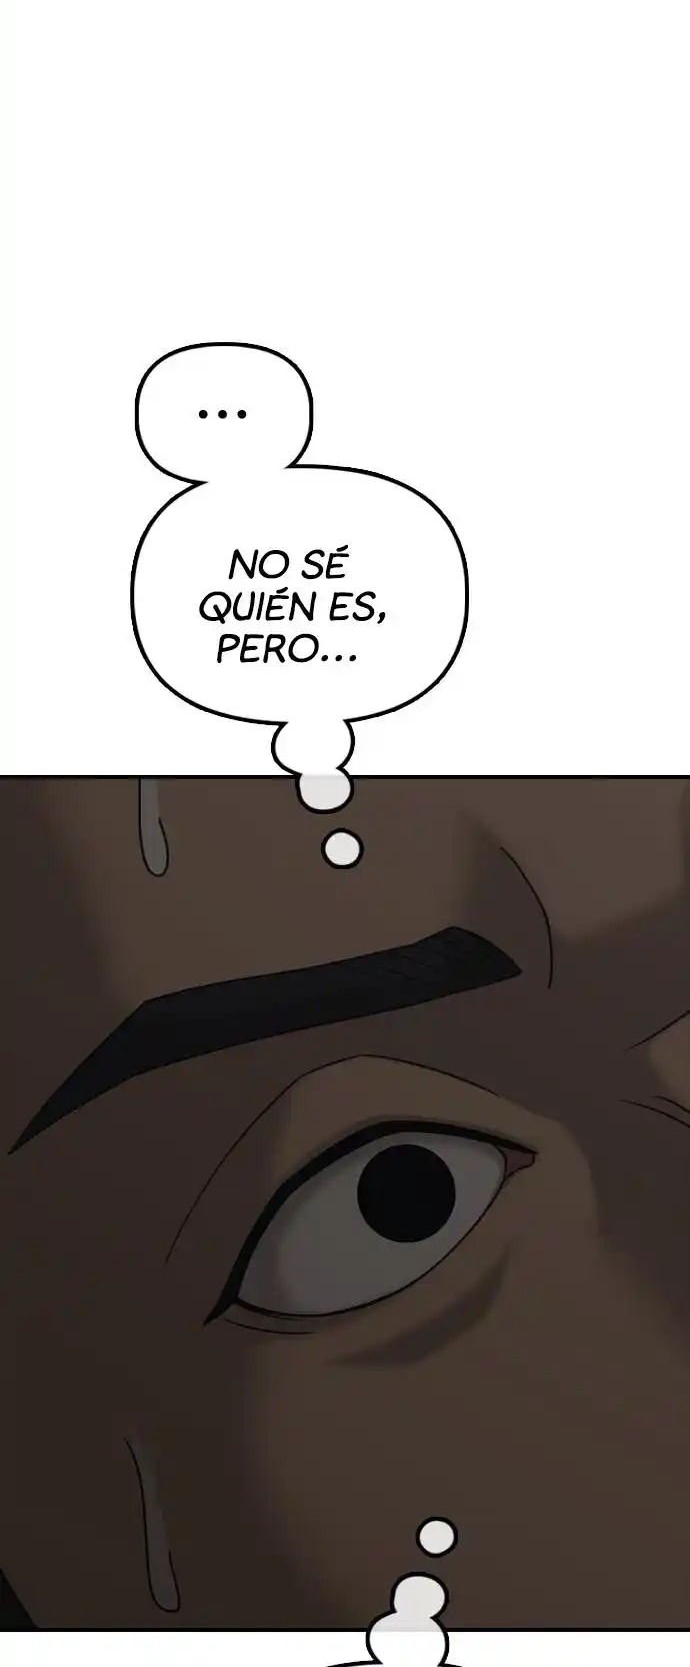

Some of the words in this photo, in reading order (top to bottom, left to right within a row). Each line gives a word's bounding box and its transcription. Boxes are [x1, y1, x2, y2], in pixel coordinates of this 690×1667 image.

[228, 548, 290, 580] NO
[301, 544, 350, 580] SÉ
[198, 586, 317, 625] QUIÉN
[329, 590, 388, 626] ES,
[216, 633, 357, 664] PERO...
